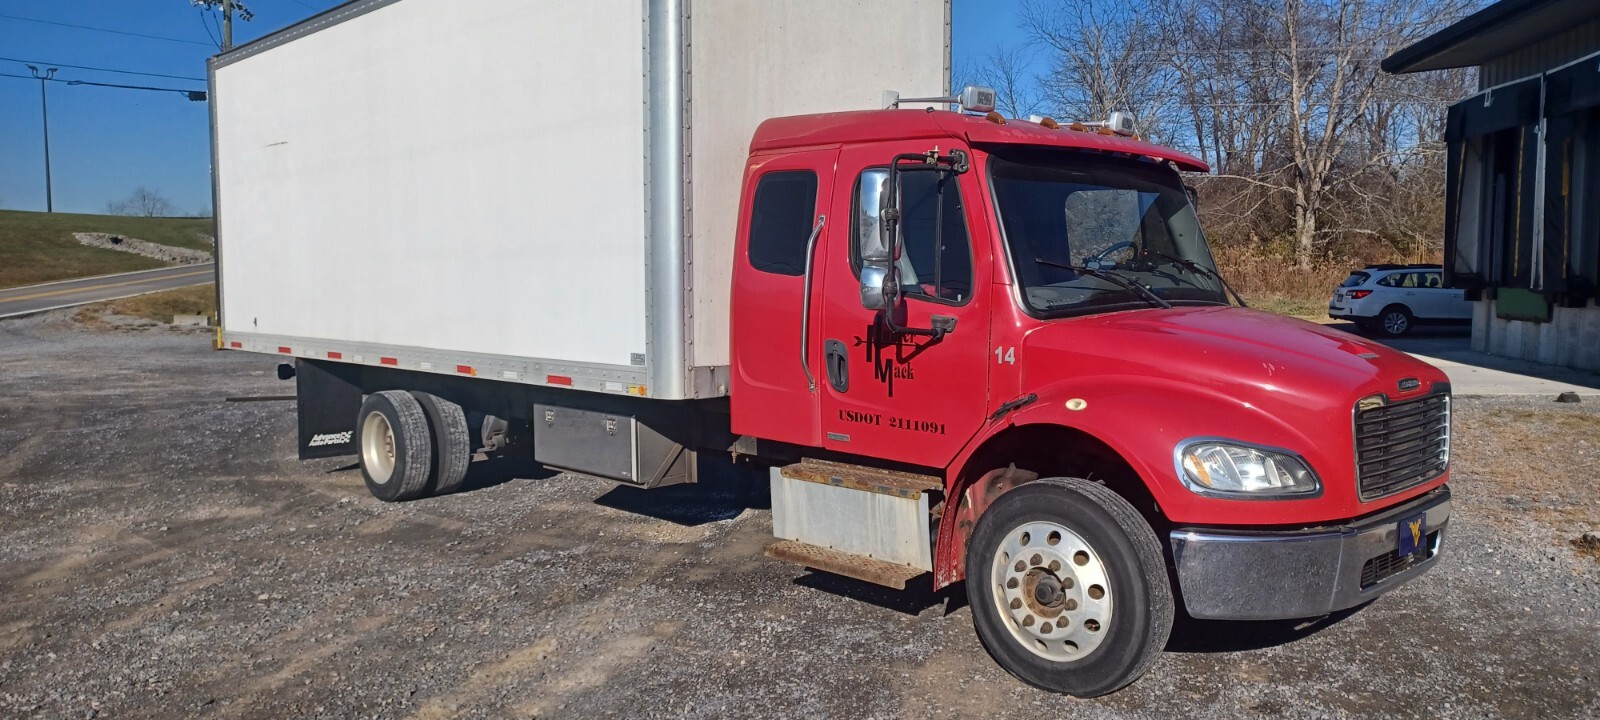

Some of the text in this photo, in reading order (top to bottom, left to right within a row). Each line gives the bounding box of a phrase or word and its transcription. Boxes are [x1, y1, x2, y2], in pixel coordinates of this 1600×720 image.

[994, 345, 1016, 365] 14
[839, 409, 947, 435] USDOT 2111091
